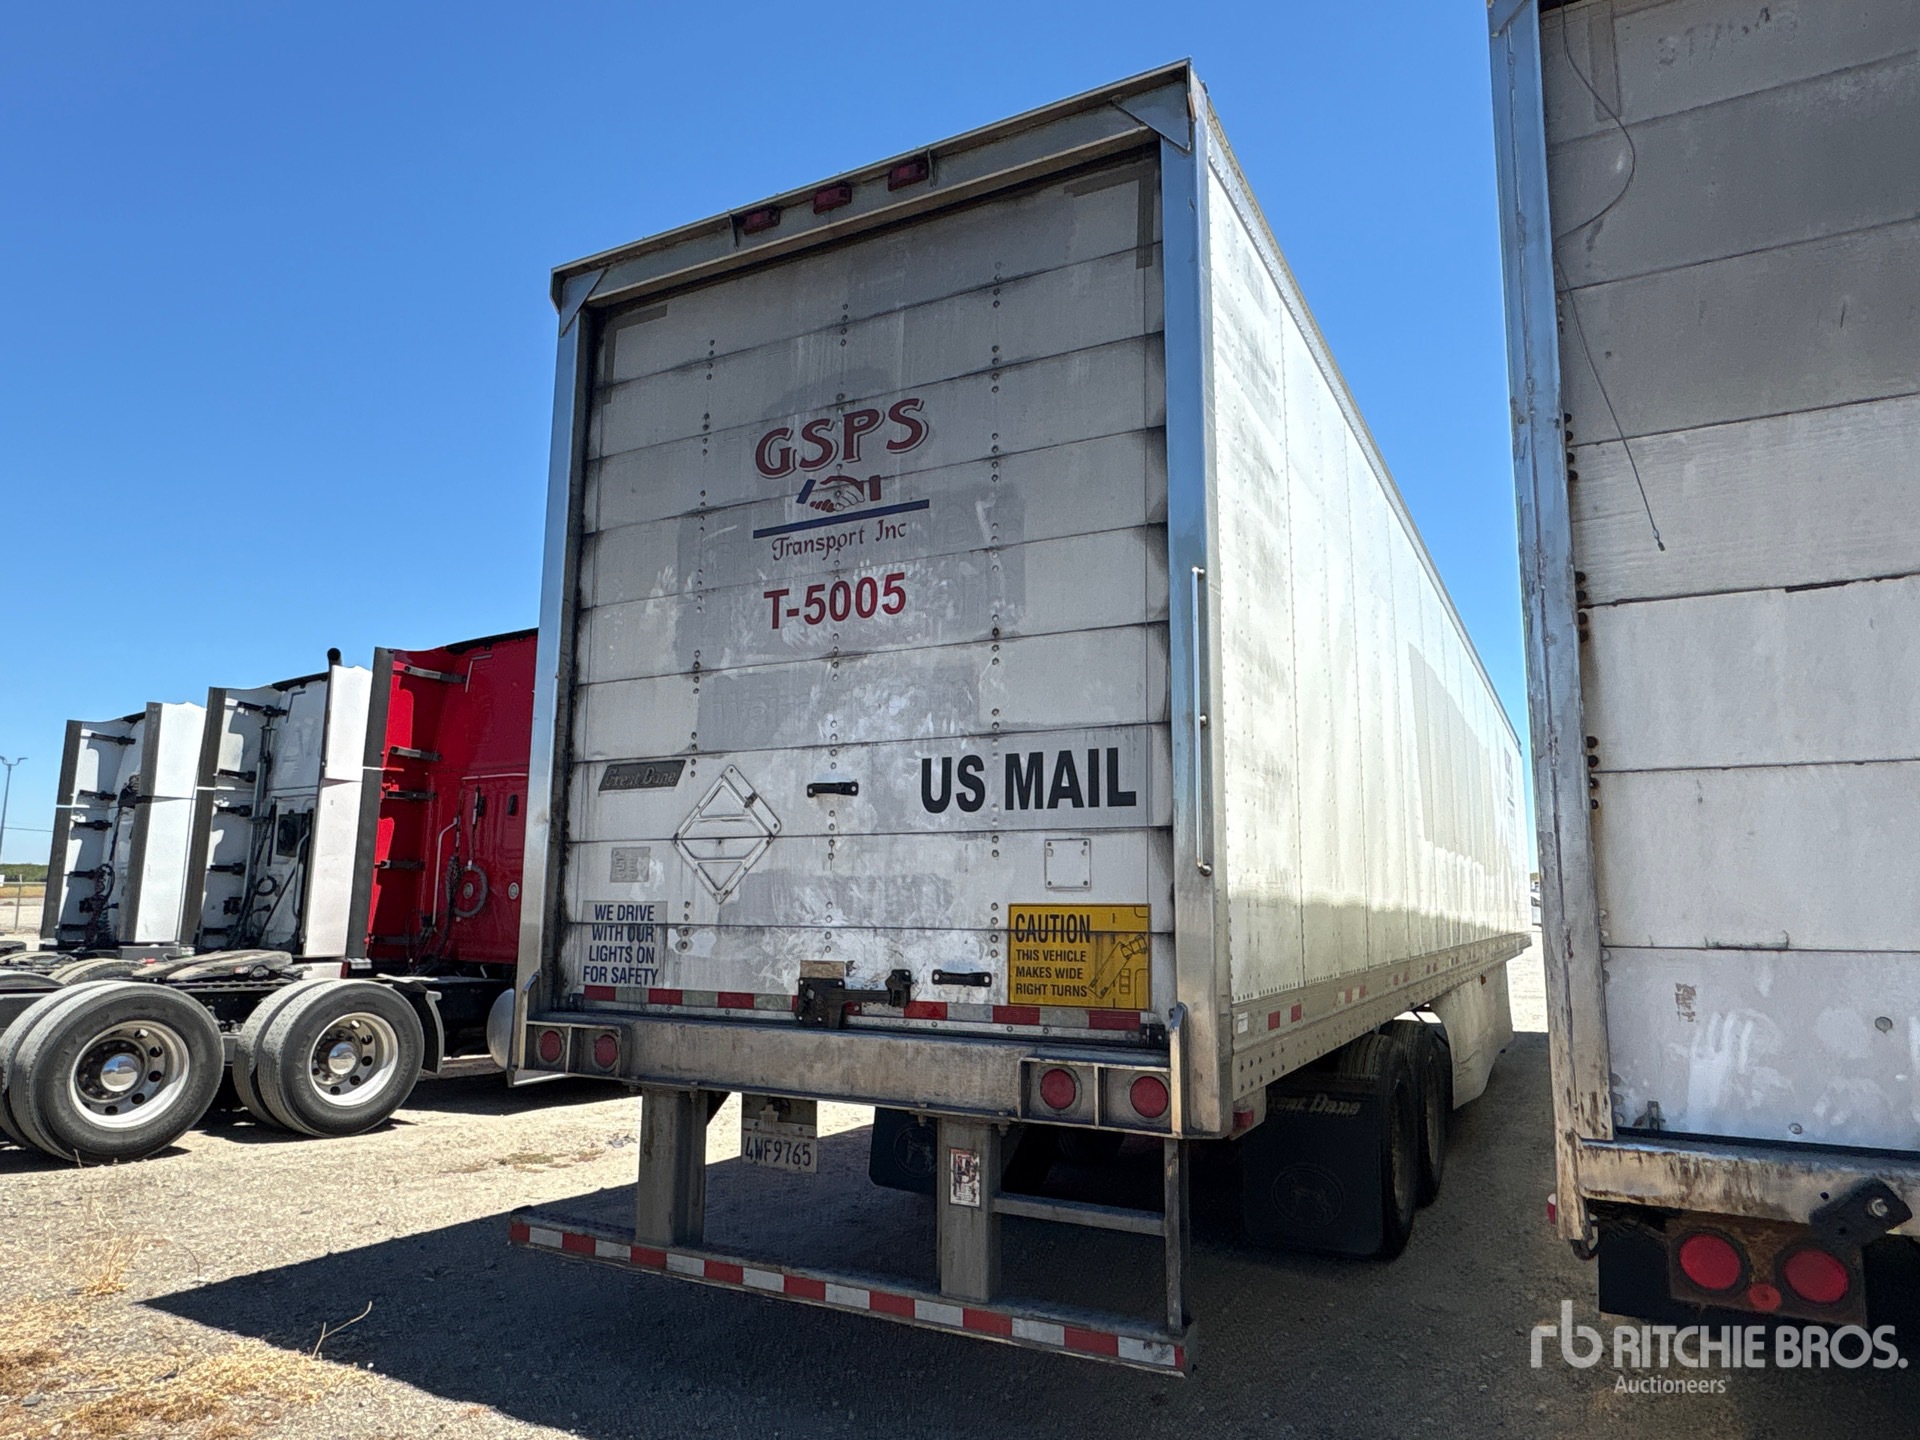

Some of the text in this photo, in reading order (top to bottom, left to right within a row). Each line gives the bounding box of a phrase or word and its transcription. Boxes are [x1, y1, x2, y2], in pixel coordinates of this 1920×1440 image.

[755, 398, 929, 479] GSPS
[771, 519, 907, 560] Transport Inc
[763, 571, 907, 629] T-5005
[921, 747, 1137, 813] US MAIL
[594, 904, 655, 921] WE DRIVE
[592, 923, 654, 943] WITH OUR
[1015, 913, 1091, 943] CAUTION
[588, 945, 655, 964] LIGHTS ON
[1015, 949, 1087, 962] THIS VEHICLE
[583, 965, 659, 985] FOR SAFETY
[1015, 966, 1084, 979] MAKES WIDE
[1015, 983, 1088, 997] RIGHT TURNS
[745, 1135, 812, 1167] 4WF9765
